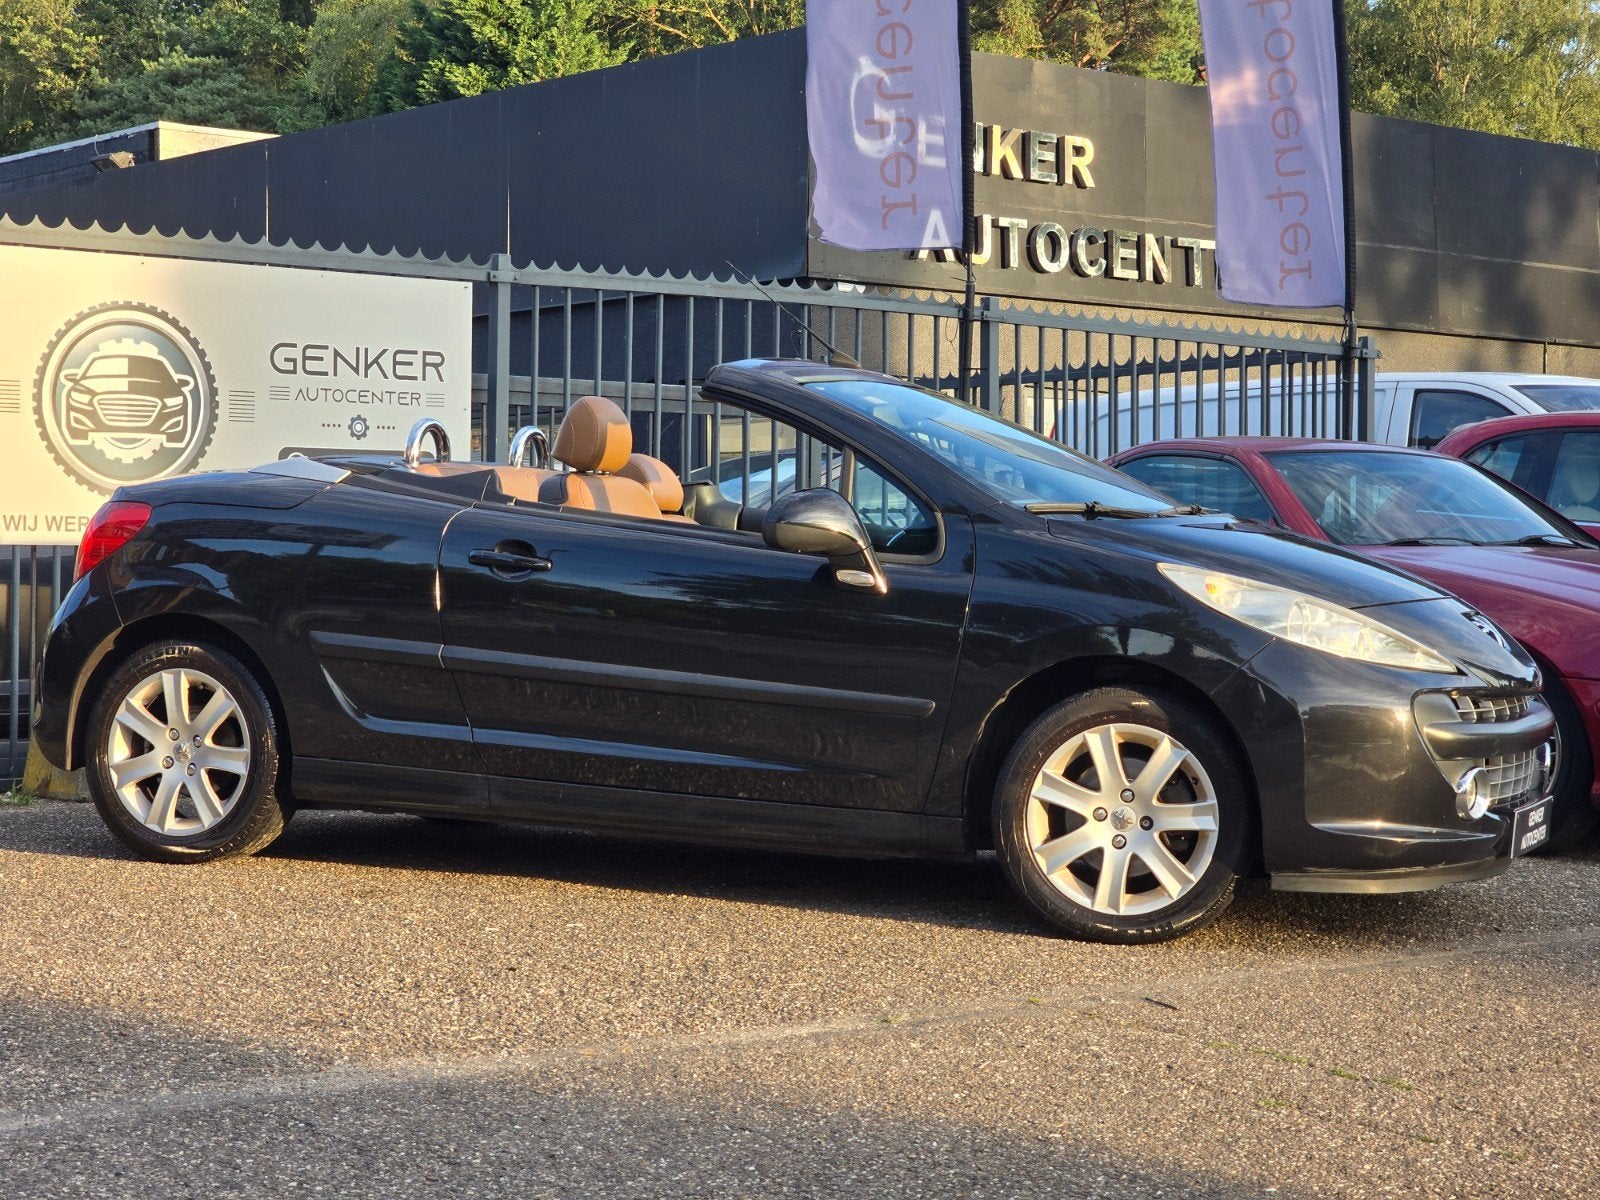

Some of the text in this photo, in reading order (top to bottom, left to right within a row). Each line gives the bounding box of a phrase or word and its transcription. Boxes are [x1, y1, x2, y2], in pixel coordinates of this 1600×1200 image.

[269, 342, 446, 383] GENKER
[294, 387, 422, 407] AUTOCENTER
[3, 515, 38, 532] WIJ
